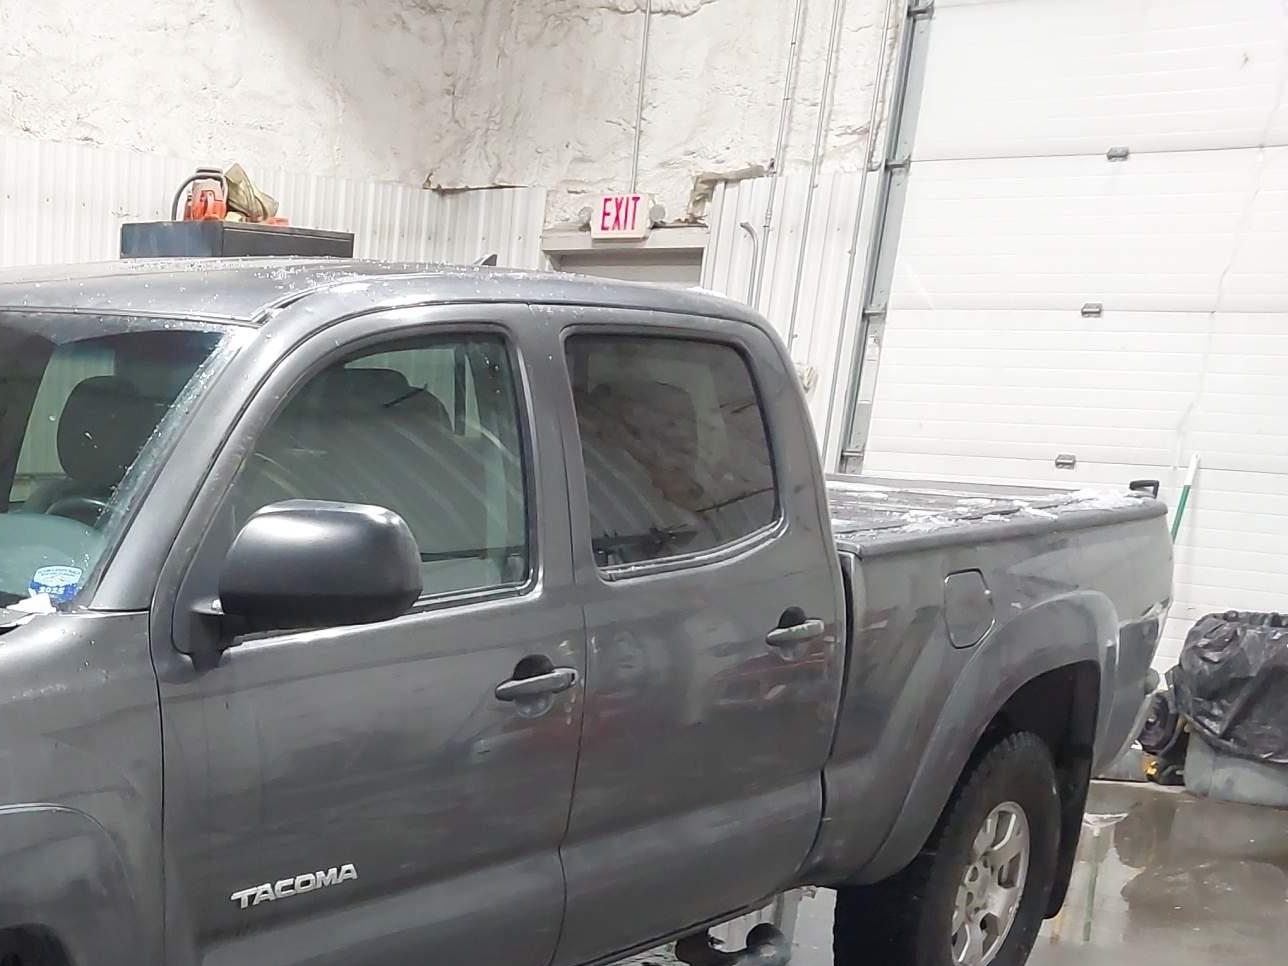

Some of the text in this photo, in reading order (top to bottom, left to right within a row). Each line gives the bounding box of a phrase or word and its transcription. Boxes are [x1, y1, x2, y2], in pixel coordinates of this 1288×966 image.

[601, 197, 640, 231] EXIT
[38, 586, 65, 594] 2025
[230, 863, 358, 909] TACOMA
